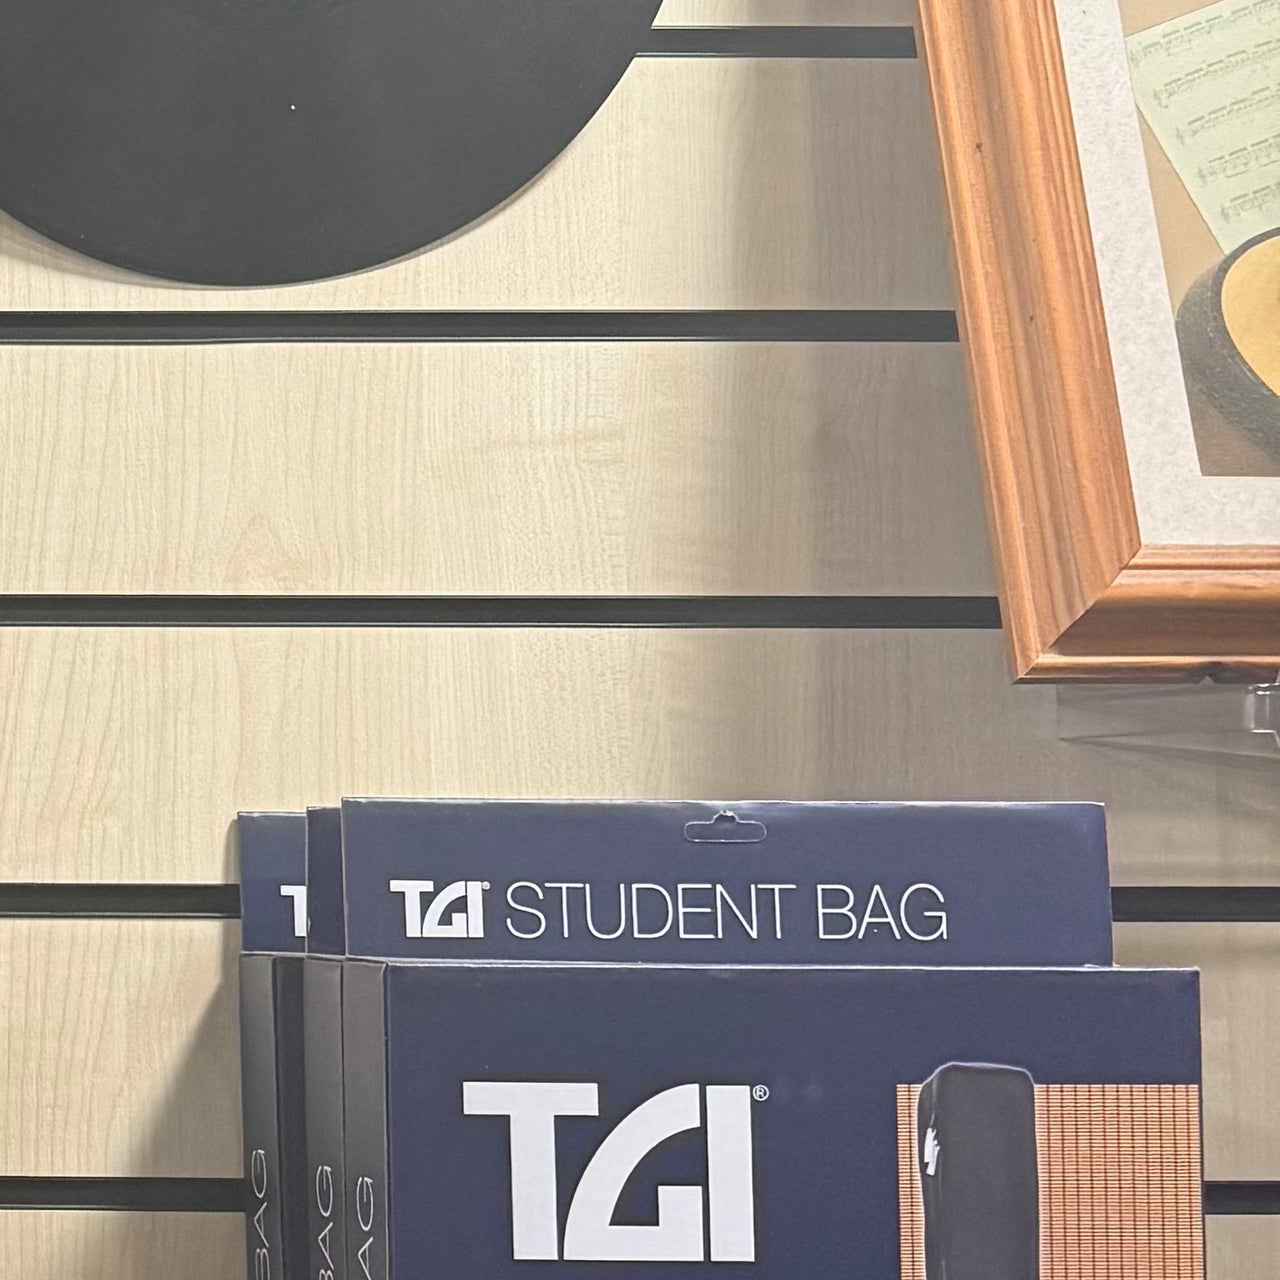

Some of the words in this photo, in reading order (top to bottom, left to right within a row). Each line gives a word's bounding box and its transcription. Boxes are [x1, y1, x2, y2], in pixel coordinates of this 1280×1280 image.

[389, 879, 484, 939] TGI
[506, 881, 797, 941] STUDENT
[816, 883, 948, 941] BAG
[463, 1081, 756, 1263] TGI
